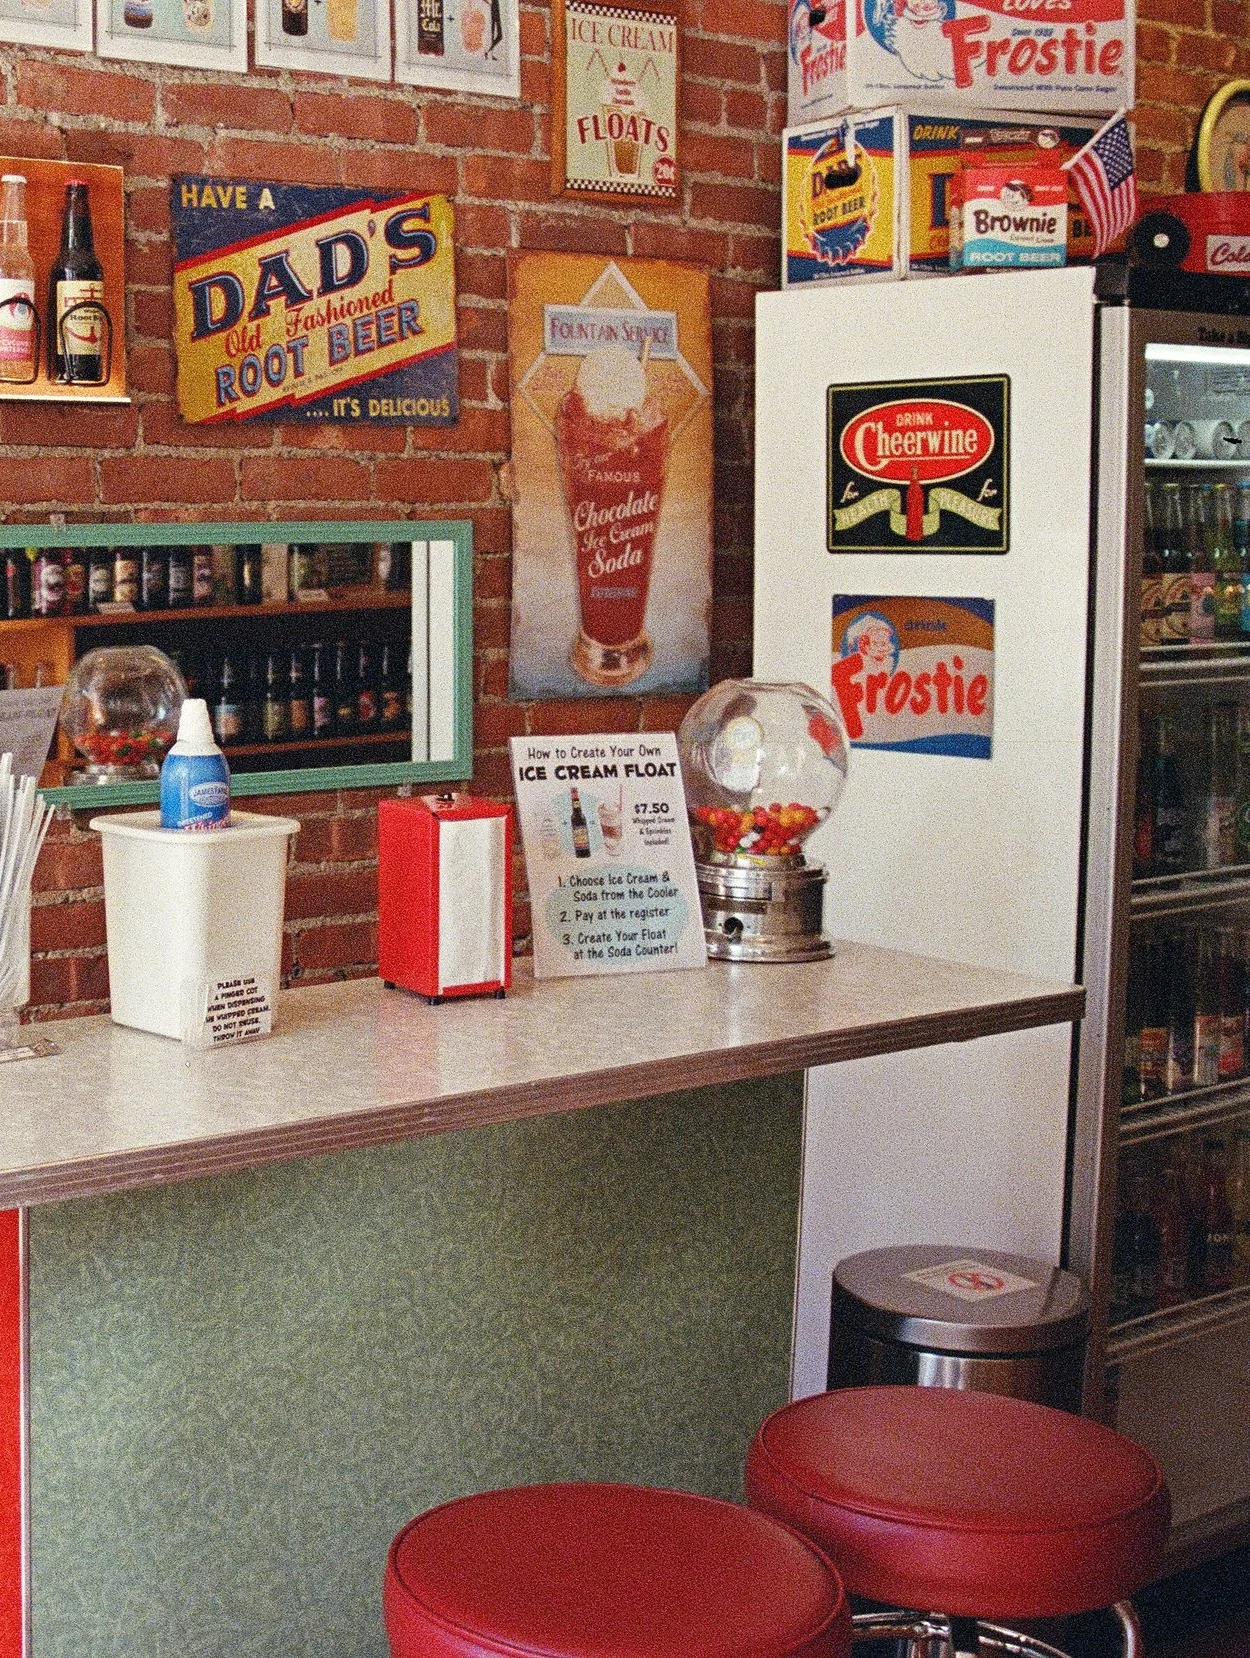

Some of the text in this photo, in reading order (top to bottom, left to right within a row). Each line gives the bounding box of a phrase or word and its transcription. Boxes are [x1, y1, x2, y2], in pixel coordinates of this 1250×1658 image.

[571, 18, 673, 53] ICE CREAM
[941, 15, 1123, 89] Frostie
[577, 113, 669, 153] FLOATS
[913, 125, 961, 141] DRINK
[181, 184, 275, 210] HAVE A
[813, 196, 866, 225] ROOT BEER
[973, 209, 1056, 236] Brownie
[969, 251, 1061, 263] ROOT BEER
[188, 202, 438, 343] DAD'S
[224, 279, 395, 359] Old Fashioned
[550, 317, 619, 343] FOUNTAIN
[214, 299, 424, 409] ROOT BEER
[368, 399, 451, 418] DELICIOUS
[896, 412, 934, 427] DRINK
[854, 421, 978, 470] Cheerwine
[587, 470, 640, 483] FAMOUS
[574, 491, 659, 532] Chocolate
[581, 520, 654, 553] Ice Cream
[588, 543, 642, 579] Soda
[831, 652, 988, 740] Frostie
[528, 744, 661, 760] How to Create Your Own
[519, 762, 677, 782] ICE CREAM FLOAT
[634, 803, 669, 815] $7.50
[557, 870, 670, 888] 1. Choose Ice Cream &
[573, 886, 679, 903] Soda from the Cooler
[559, 907, 670, 924] 2. Pay at the register
[562, 928, 667, 946] 3. Create Your Float
[573, 942, 679, 961] at the Soda Counter!
[217, 979, 242, 989] PLEASE
[221, 989, 245, 999] FINGER
[246, 986, 259, 995] COT
[212, 1024, 223, 1033] DO
[224, 1021, 238, 1030] NOT
[213, 1031, 235, 1042] THROW
[236, 1030, 243, 1039] IT
